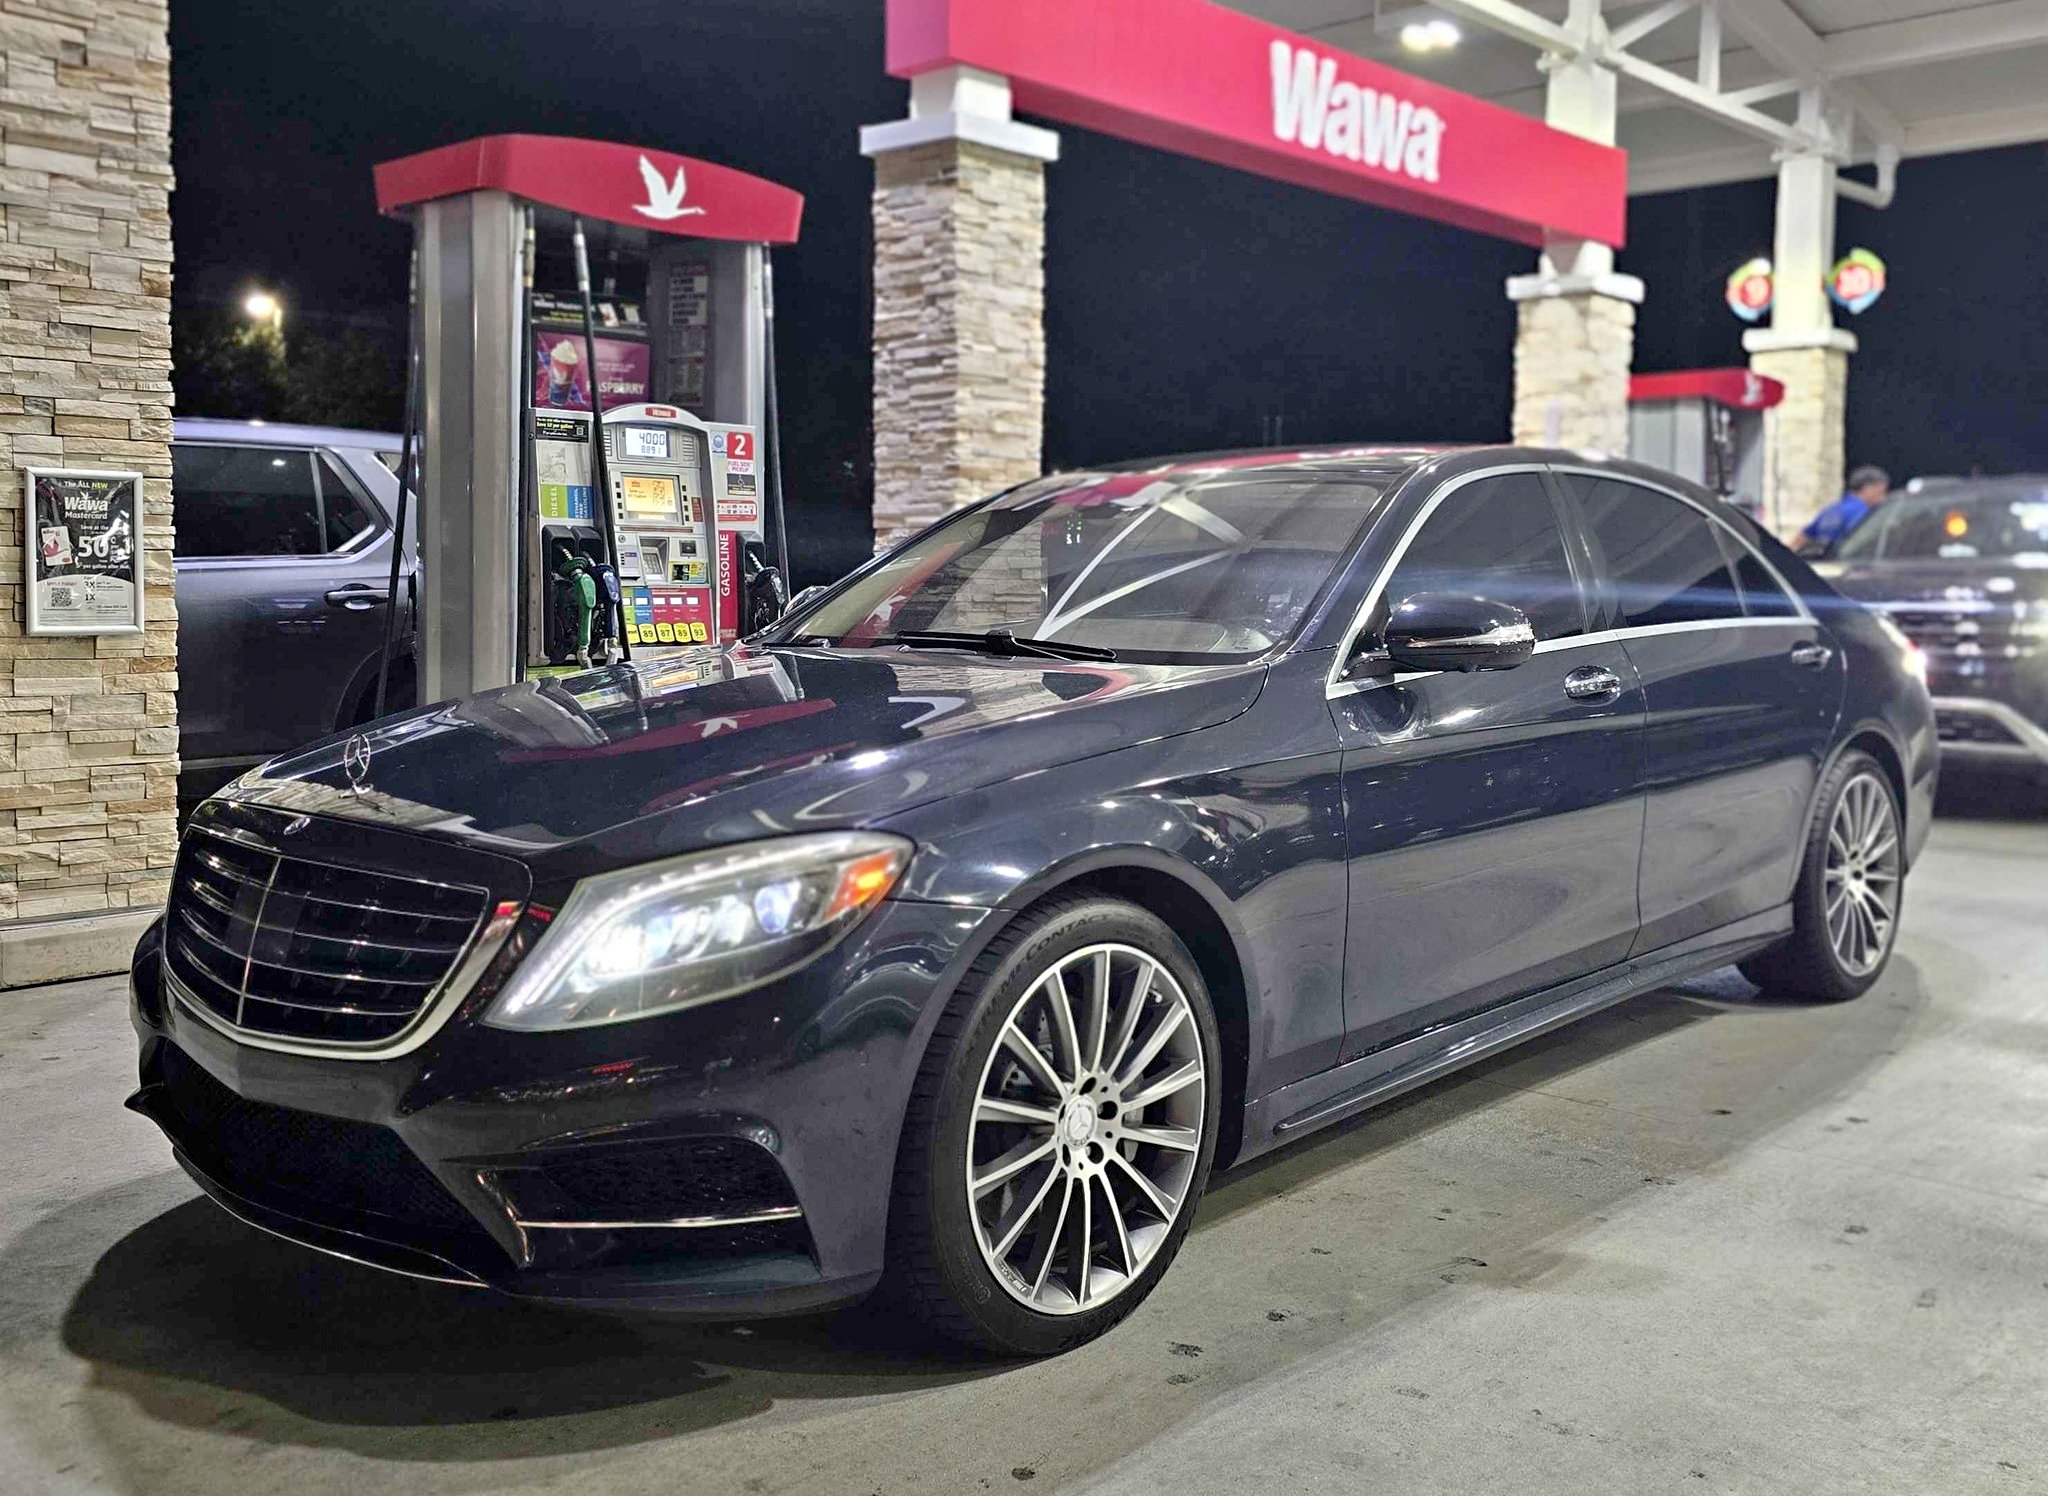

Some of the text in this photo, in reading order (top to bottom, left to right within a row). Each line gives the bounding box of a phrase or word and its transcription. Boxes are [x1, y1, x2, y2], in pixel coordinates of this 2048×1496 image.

[1270, 39, 1440, 182] Wawa
[586, 381, 645, 394] SPBERRY
[734, 434, 746, 456] 2
[64, 480, 76, 488] The
[78, 481, 90, 489] ALL
[64, 496, 109, 512] Wawa
[550, 487, 558, 517] DIESEL
[64, 511, 108, 520] Mastercard
[720, 534, 730, 596] GASOLINE
[643, 630, 654, 638] 89
[661, 629, 670, 637] 87
[677, 629, 687, 637] 89
[693, 628, 704, 636] 93
